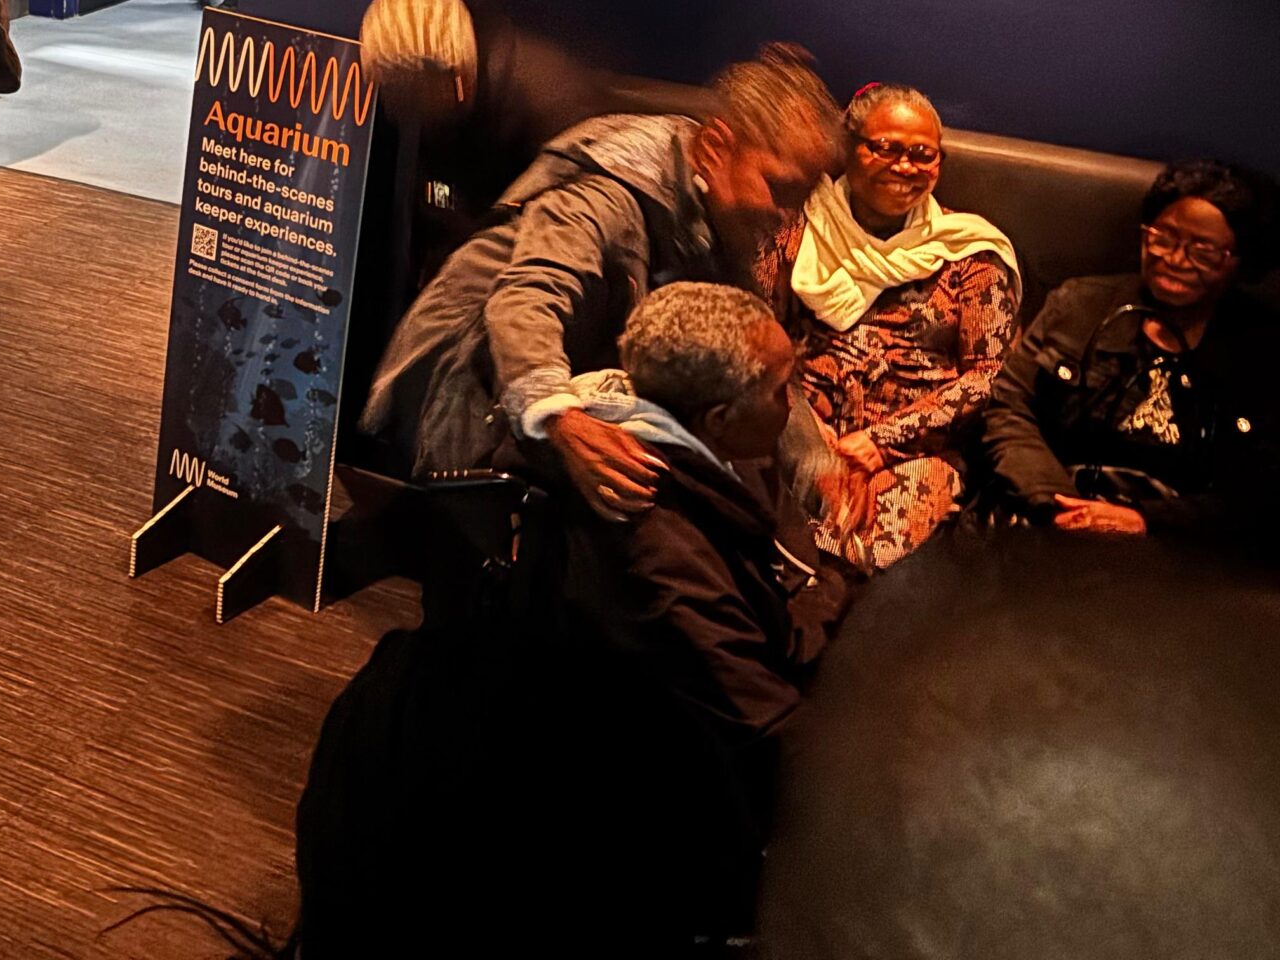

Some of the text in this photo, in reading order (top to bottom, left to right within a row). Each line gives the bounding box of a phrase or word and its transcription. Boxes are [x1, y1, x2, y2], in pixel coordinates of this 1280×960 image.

[201, 137, 296, 178] Meet here for
[204, 100, 350, 167] Aquarium
[197, 178, 333, 235] tours and aquarium
[199, 158, 334, 212] behind-the-scenes
[195, 197, 337, 257] keeper experiences.
[207, 469, 230, 486] World
